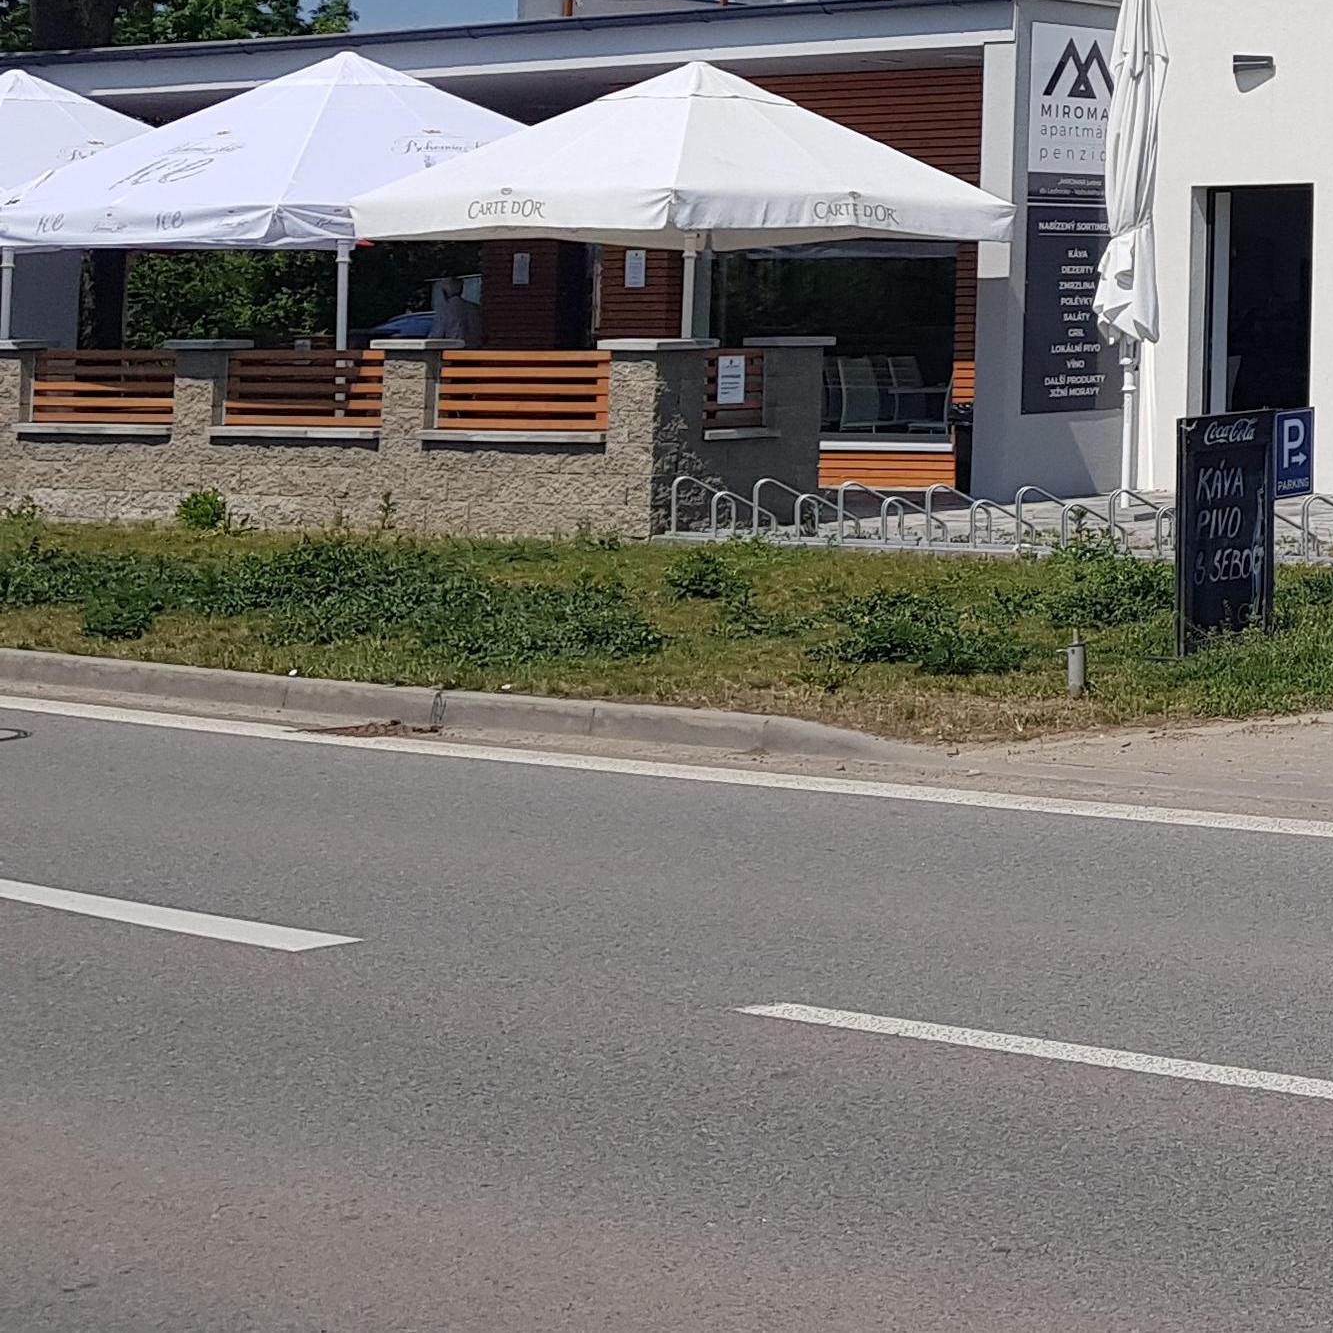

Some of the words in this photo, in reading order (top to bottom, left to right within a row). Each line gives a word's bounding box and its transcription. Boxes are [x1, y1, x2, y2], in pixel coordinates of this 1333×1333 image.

[1040, 103, 1109, 121] MIROMA
[1040, 124, 1106, 139] apartmá
[1039, 147, 1106, 162] penzio
[468, 200, 508, 219] CARTE
[813, 201, 859, 219] CARTE
[1076, 222, 1109, 231] SORTIME
[1067, 247, 1088, 258] KÁVA
[1061, 265, 1095, 274] DEZERTY
[1060, 295, 1093, 306] POLÉVKY
[1063, 311, 1091, 321] SALÁTY
[1051, 342, 1082, 353] LOKÁLNÍ
[1083, 344, 1101, 353] PIVO
[1066, 358, 1085, 369] VÍNO
[1067, 374, 1106, 385] PRODUKTY
[1283, 418, 1305, 469] P
[1196, 459, 1244, 505] KÁVA
[1277, 477, 1310, 491] PARKING
[1197, 506, 1242, 540] PIVO
